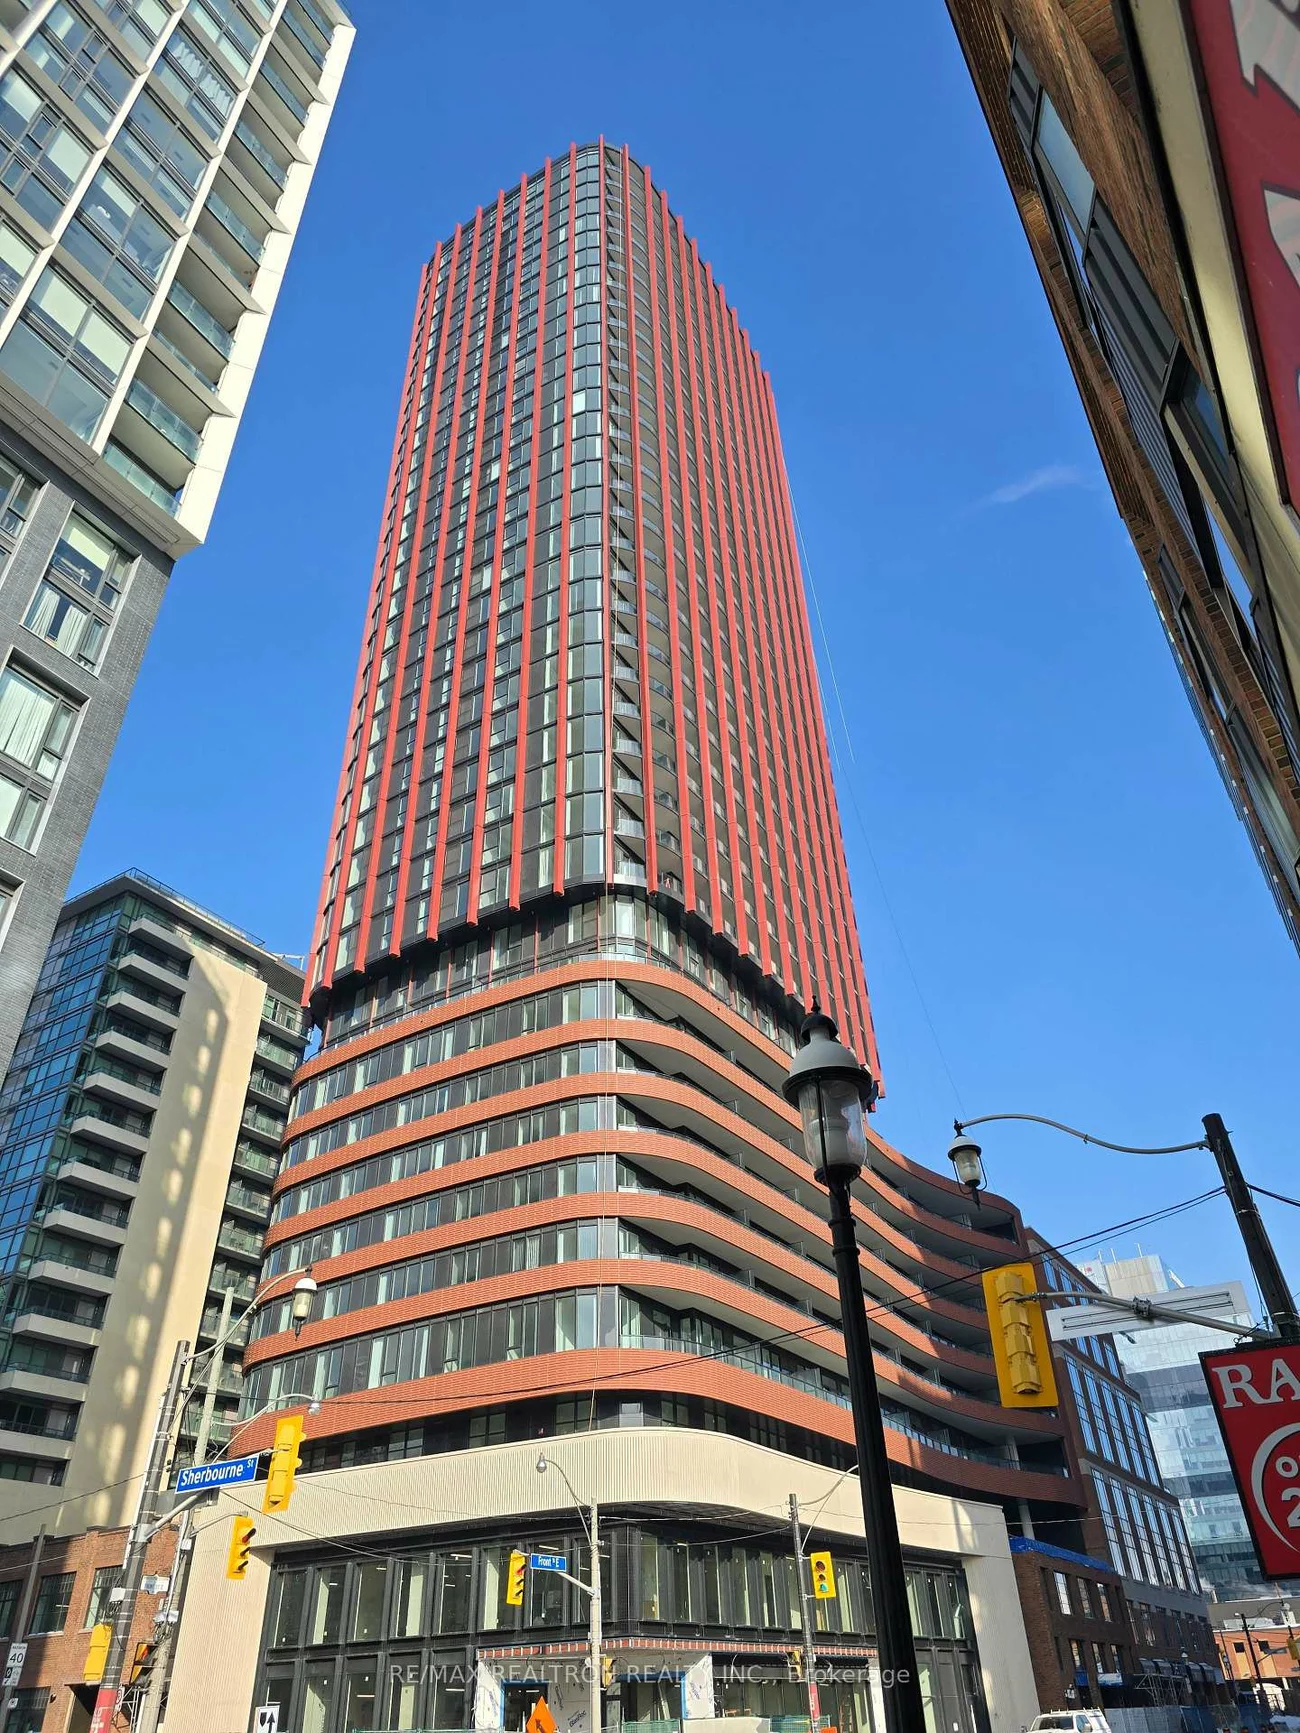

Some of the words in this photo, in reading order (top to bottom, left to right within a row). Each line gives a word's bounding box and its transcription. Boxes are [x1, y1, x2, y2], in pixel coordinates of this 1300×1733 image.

[181, 1464, 244, 1486] Sherbourne
[247, 1459, 255, 1468] St
[538, 1556, 552, 1567] Front
[555, 1558, 560, 1568] E
[9, 1652, 24, 1664] 40
